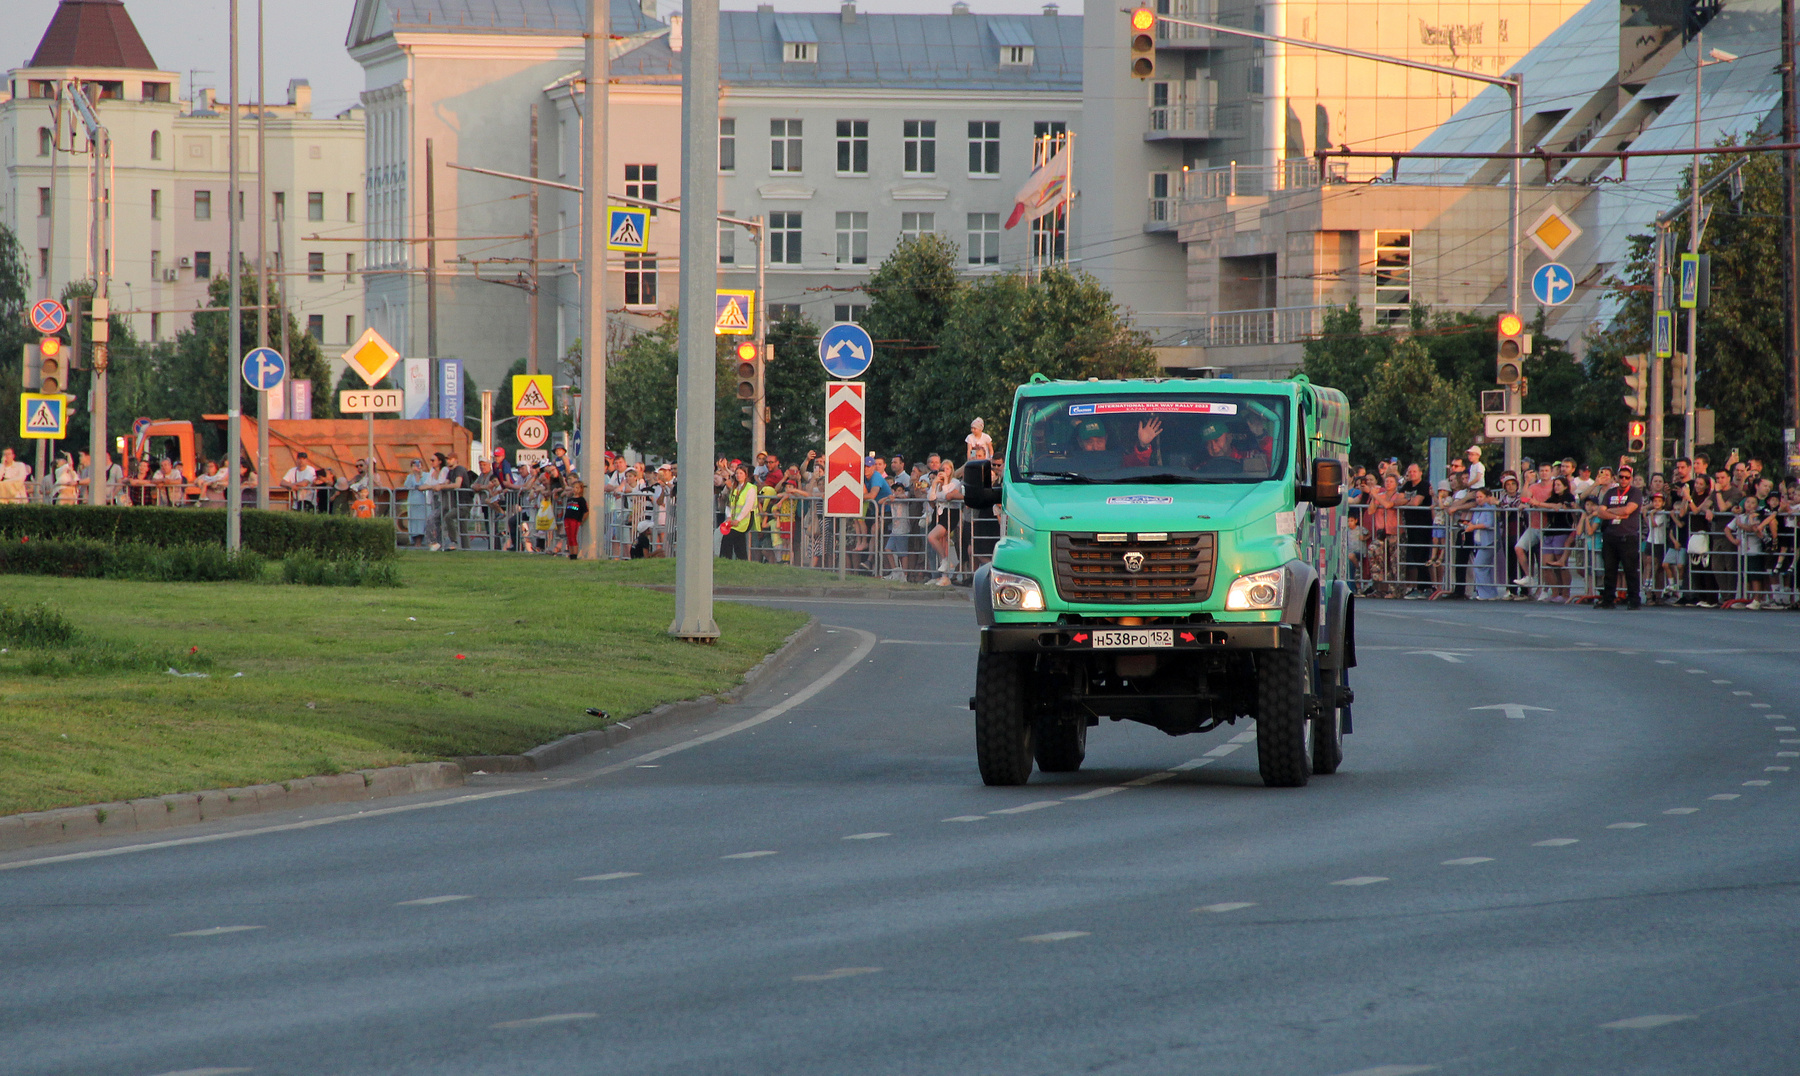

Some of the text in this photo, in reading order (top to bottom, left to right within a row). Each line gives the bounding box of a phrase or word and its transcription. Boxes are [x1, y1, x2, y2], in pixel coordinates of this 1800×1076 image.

[447, 382, 456, 394] 10
[347, 395, 396, 408] СТОП
[1495, 418, 1541, 432] СТОП
[524, 427, 541, 438] 40
[1097, 631, 1169, 646] Н538РО 152
